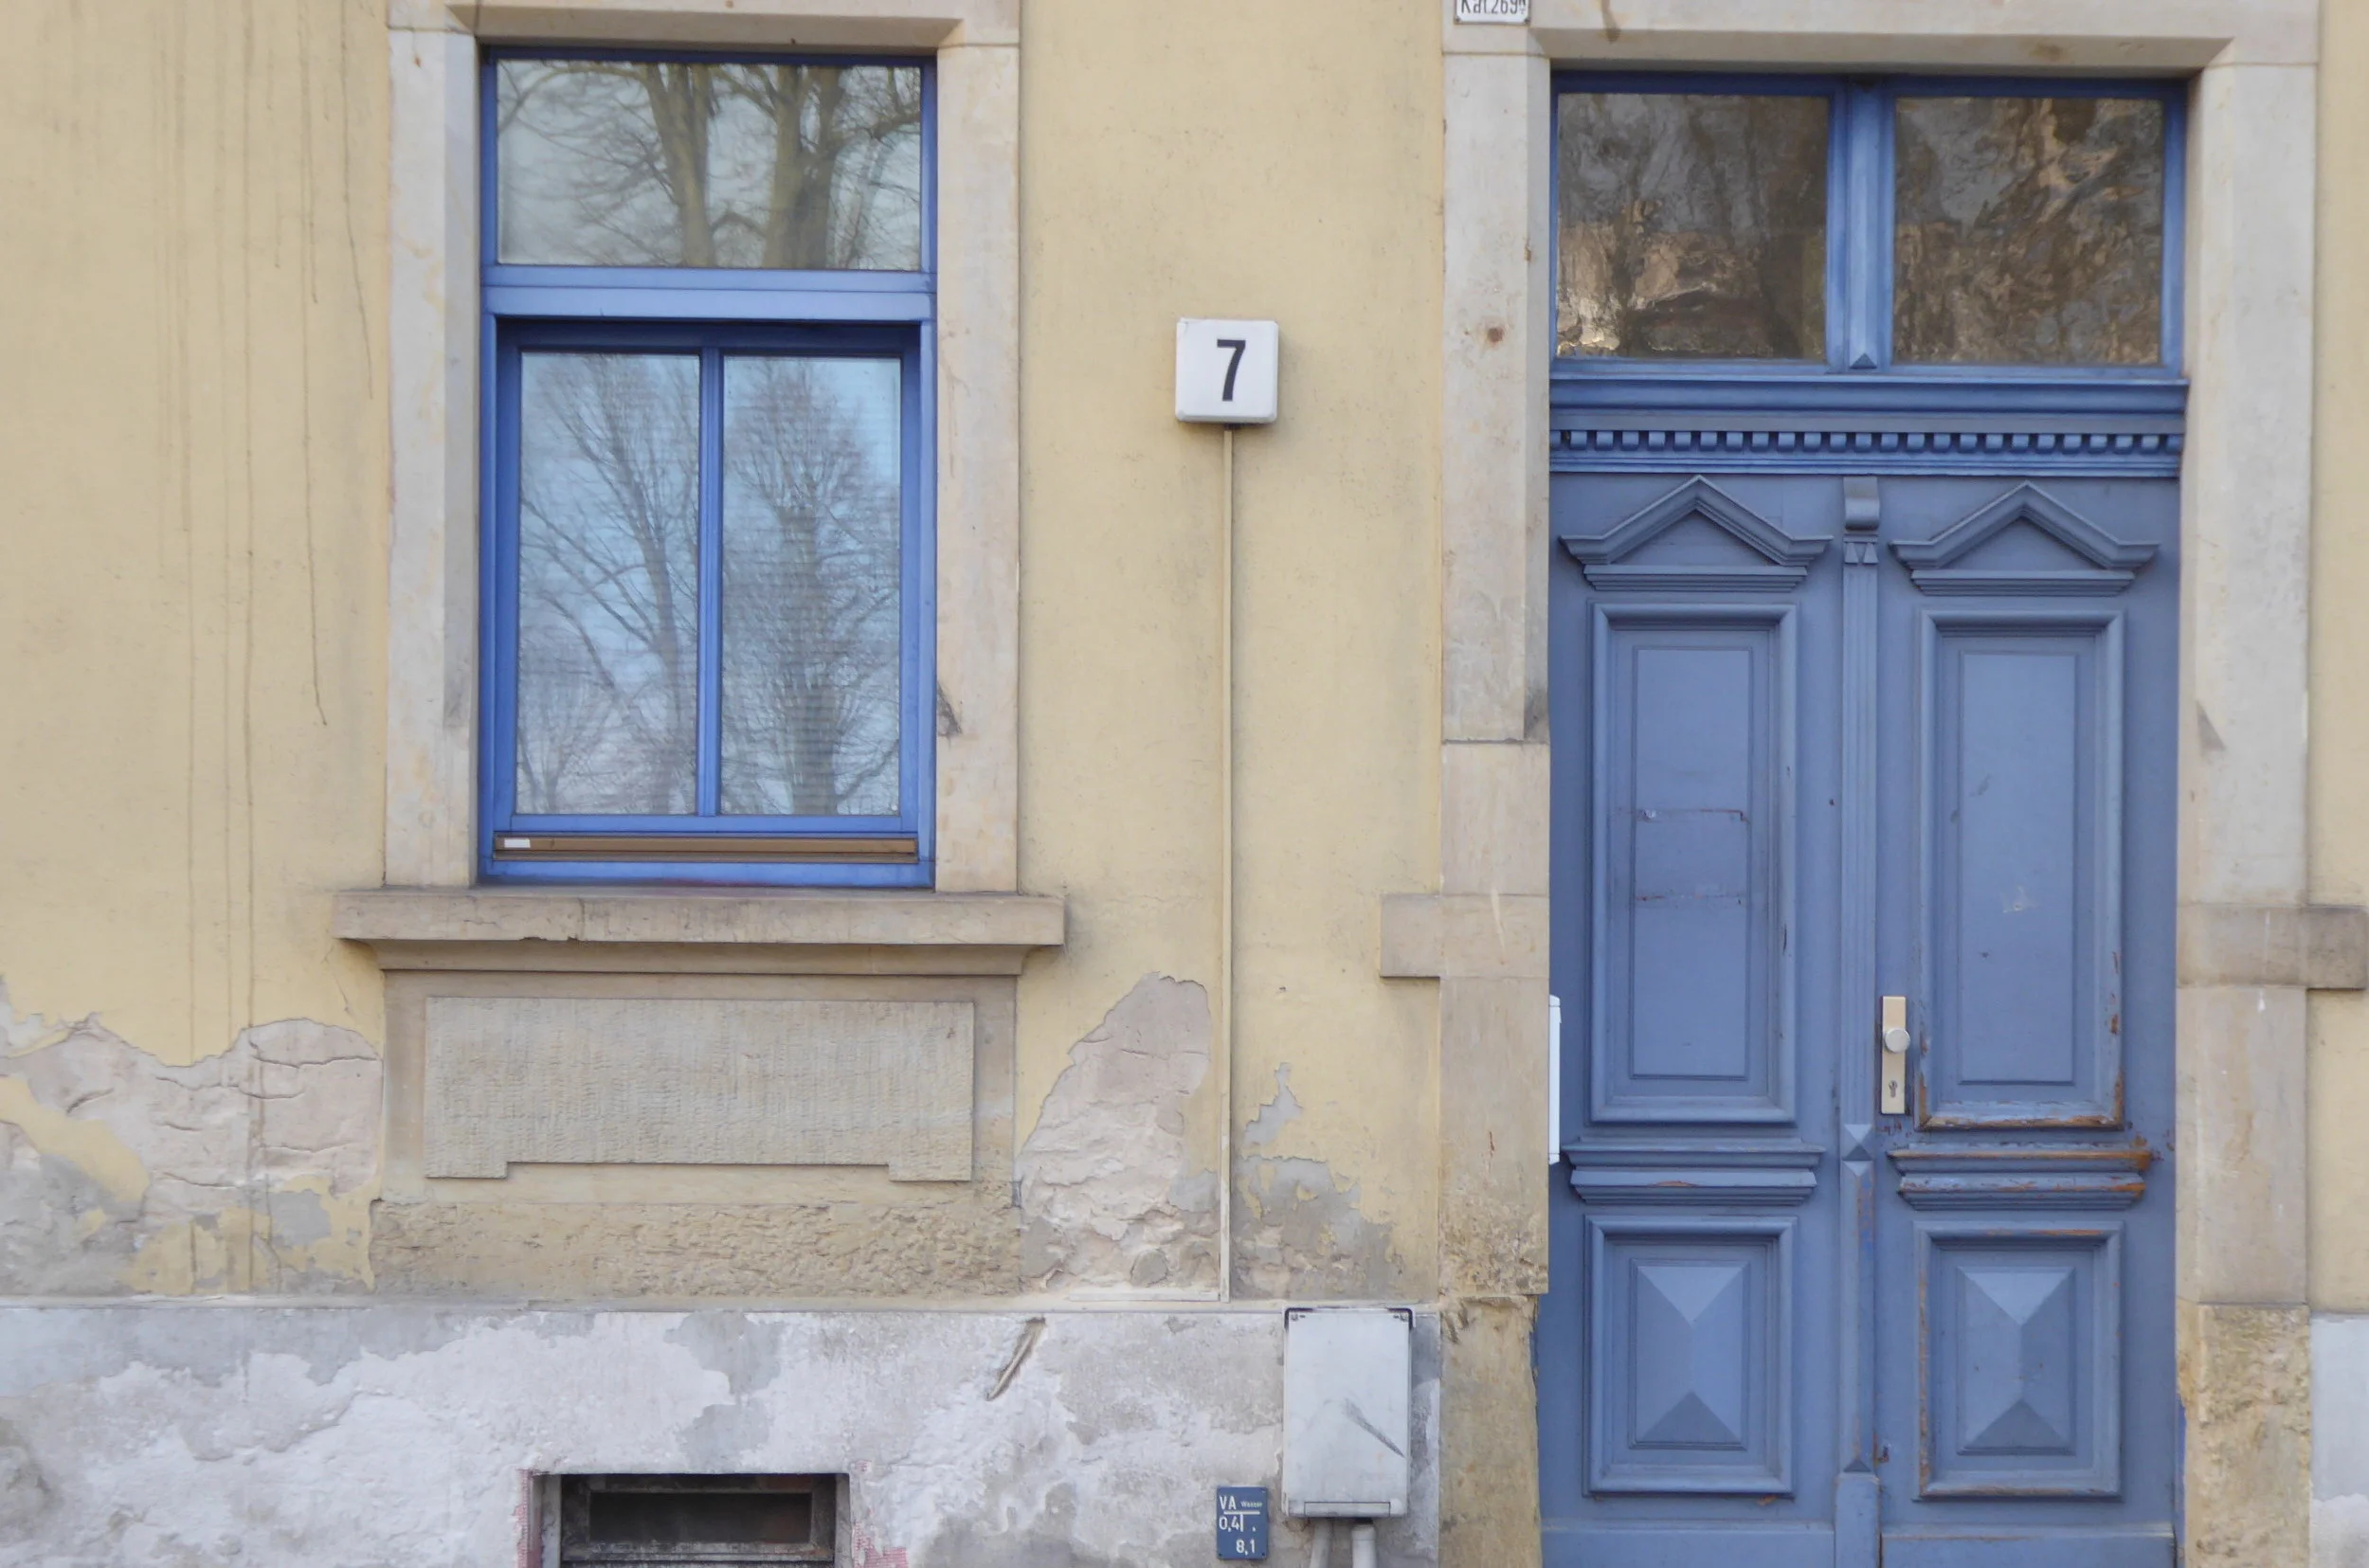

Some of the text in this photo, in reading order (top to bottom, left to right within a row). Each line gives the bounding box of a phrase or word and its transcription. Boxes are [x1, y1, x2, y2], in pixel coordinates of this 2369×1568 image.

[1217, 338, 1246, 402] 7
[1219, 1495, 1237, 1510] VA
[1219, 1516, 1239, 1533] 0,4
[1236, 1539, 1256, 1556] 8,1
